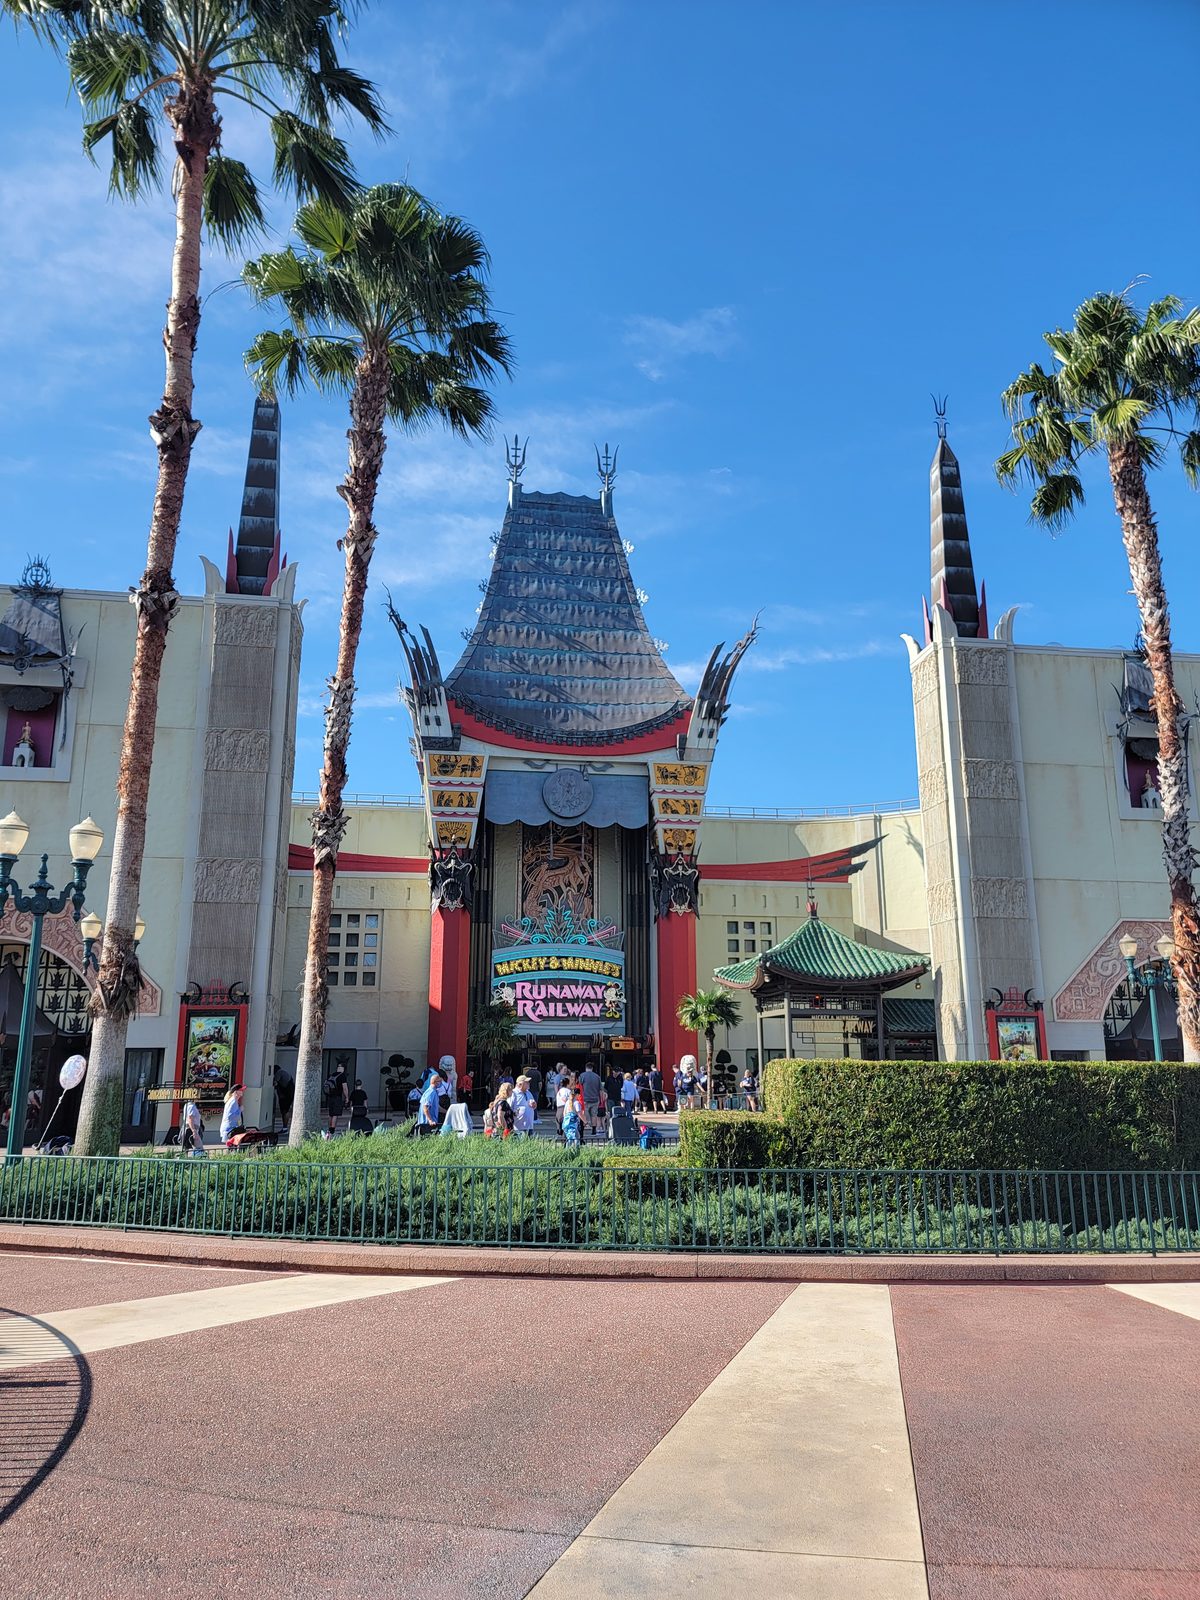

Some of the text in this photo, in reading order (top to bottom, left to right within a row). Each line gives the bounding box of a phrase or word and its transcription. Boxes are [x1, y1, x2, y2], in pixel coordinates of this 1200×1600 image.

[496, 956, 621, 977] MICKEY & MINNIE'S
[515, 982, 605, 1000] RUNAWAY
[517, 1000, 603, 1023] RAILWAY
